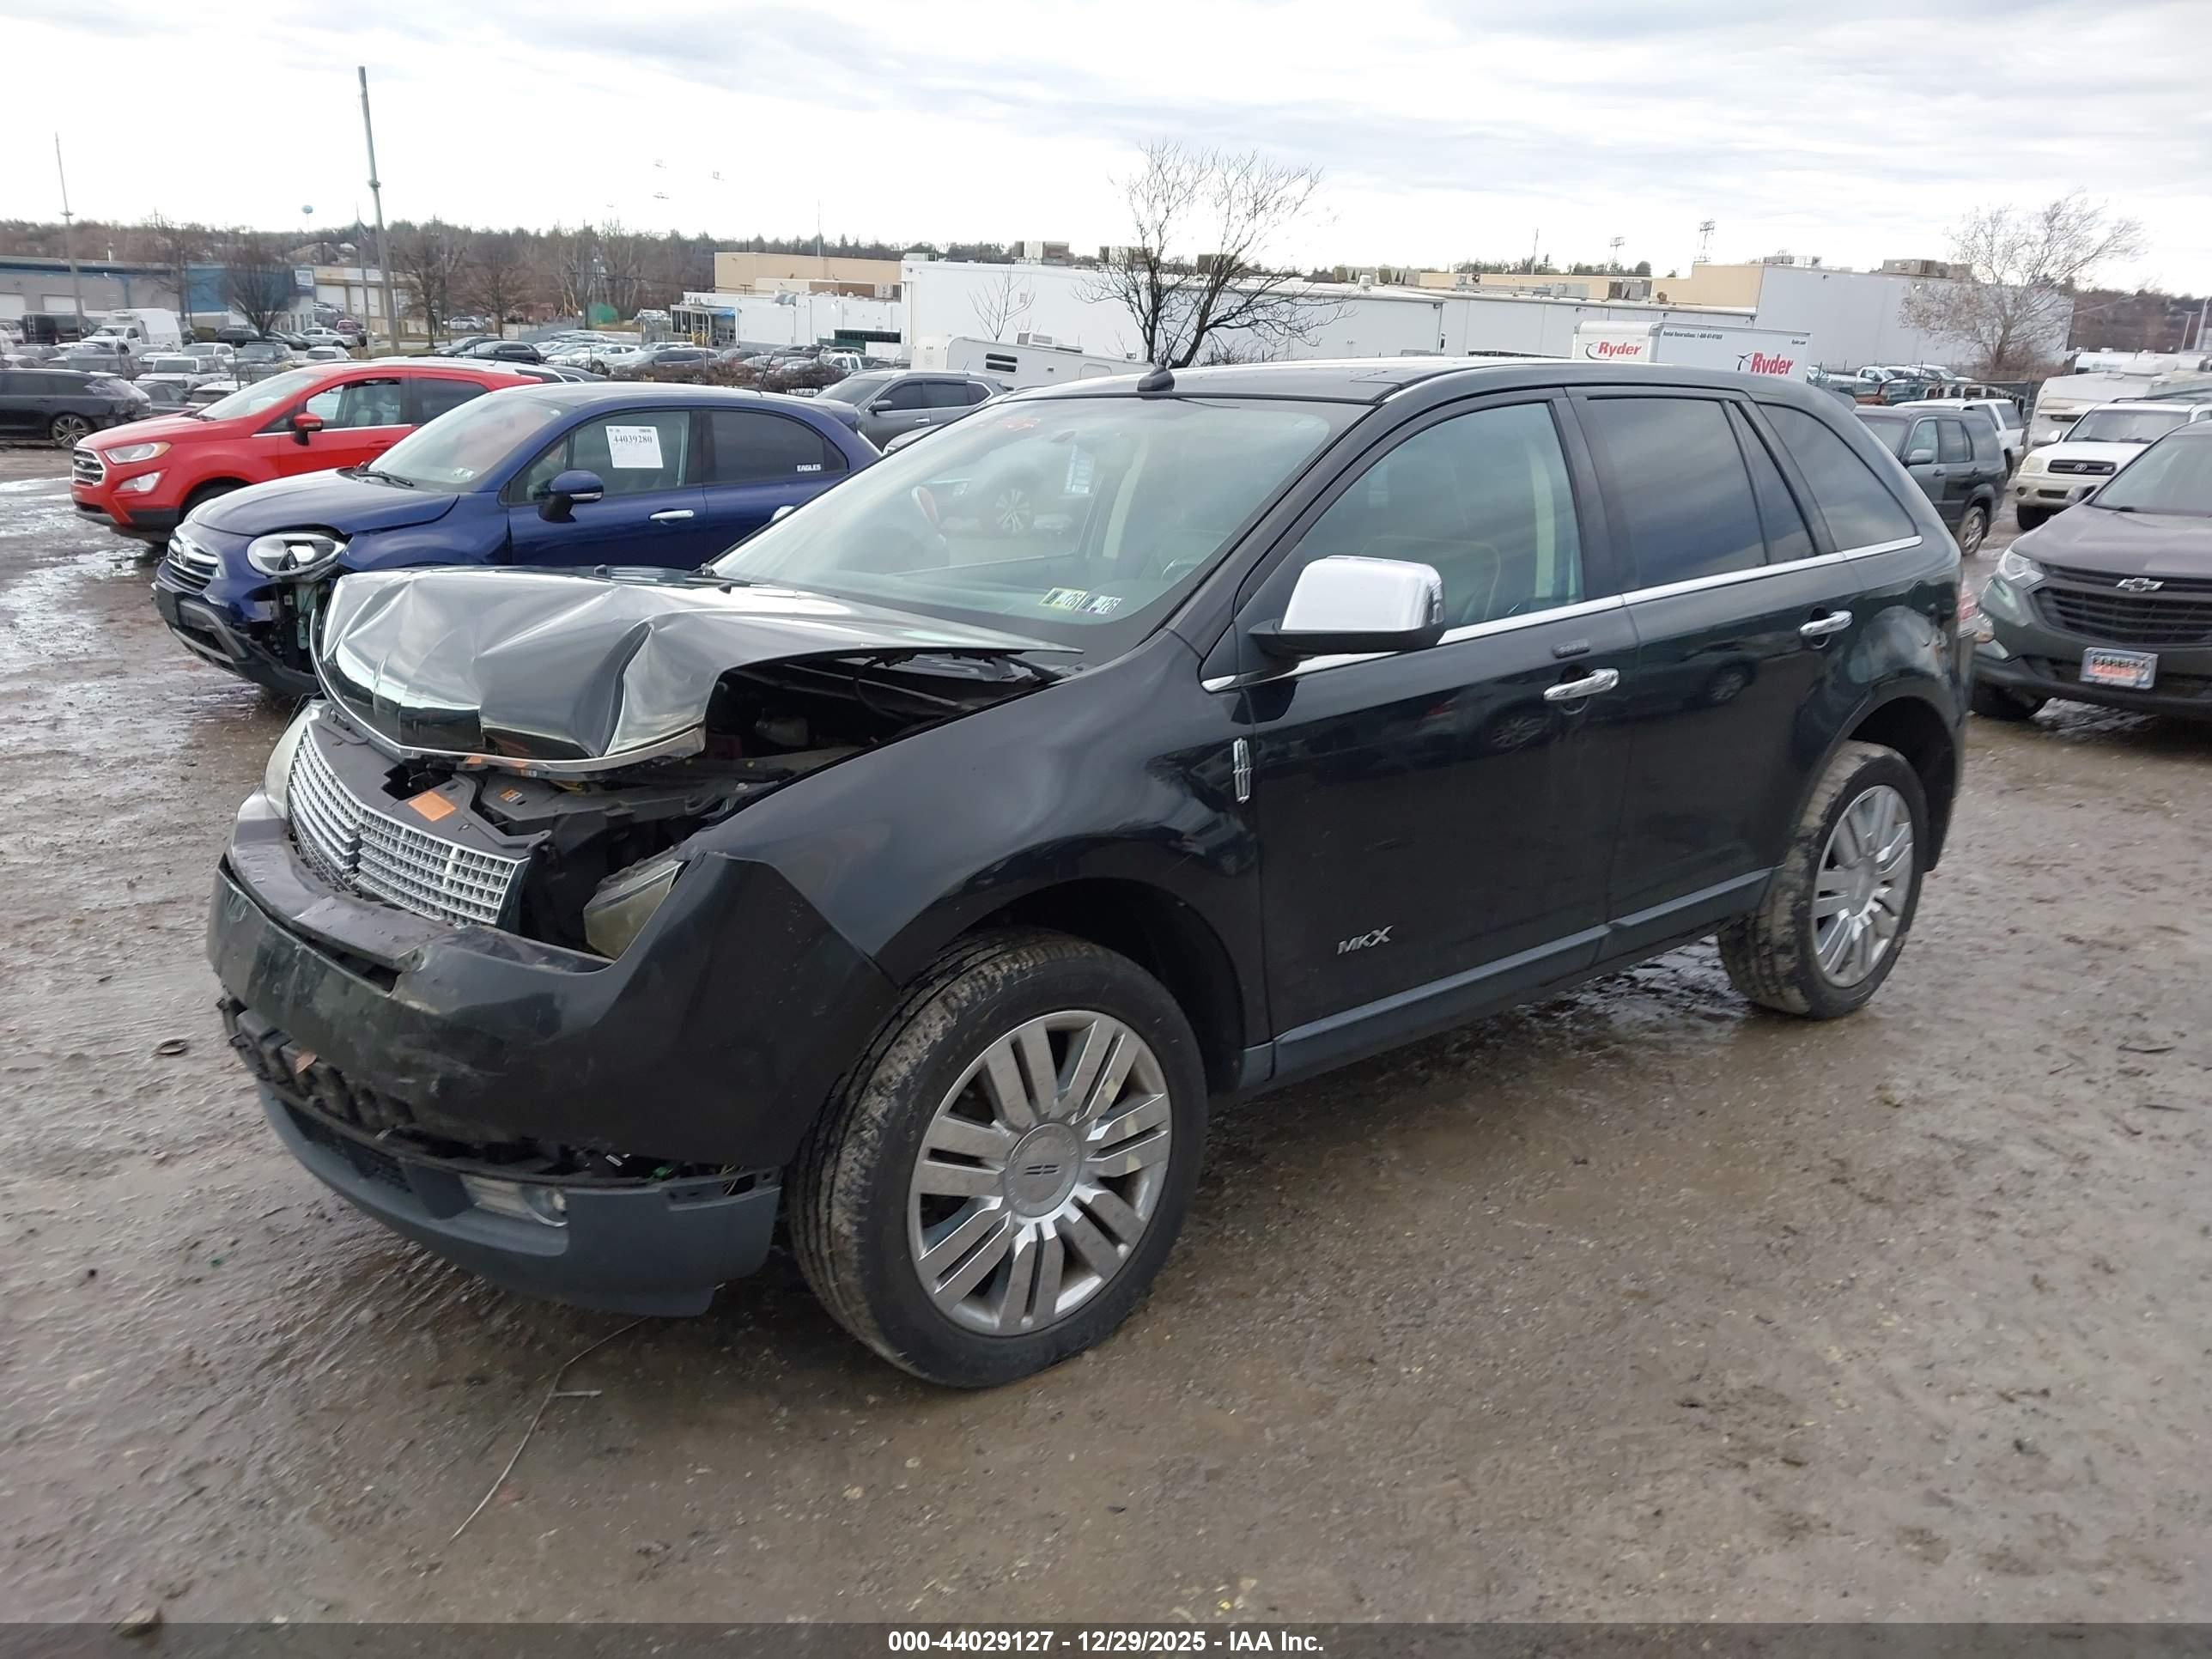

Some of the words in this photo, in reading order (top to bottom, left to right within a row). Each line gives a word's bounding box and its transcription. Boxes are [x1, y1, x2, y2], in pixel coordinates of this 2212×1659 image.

[1598, 342, 1642, 357] Ryder
[1751, 353, 1794, 374] Ryder
[613, 434, 653, 443] 44039280
[797, 464, 821, 472] EAGLES
[1337, 926, 1394, 955] MKX
